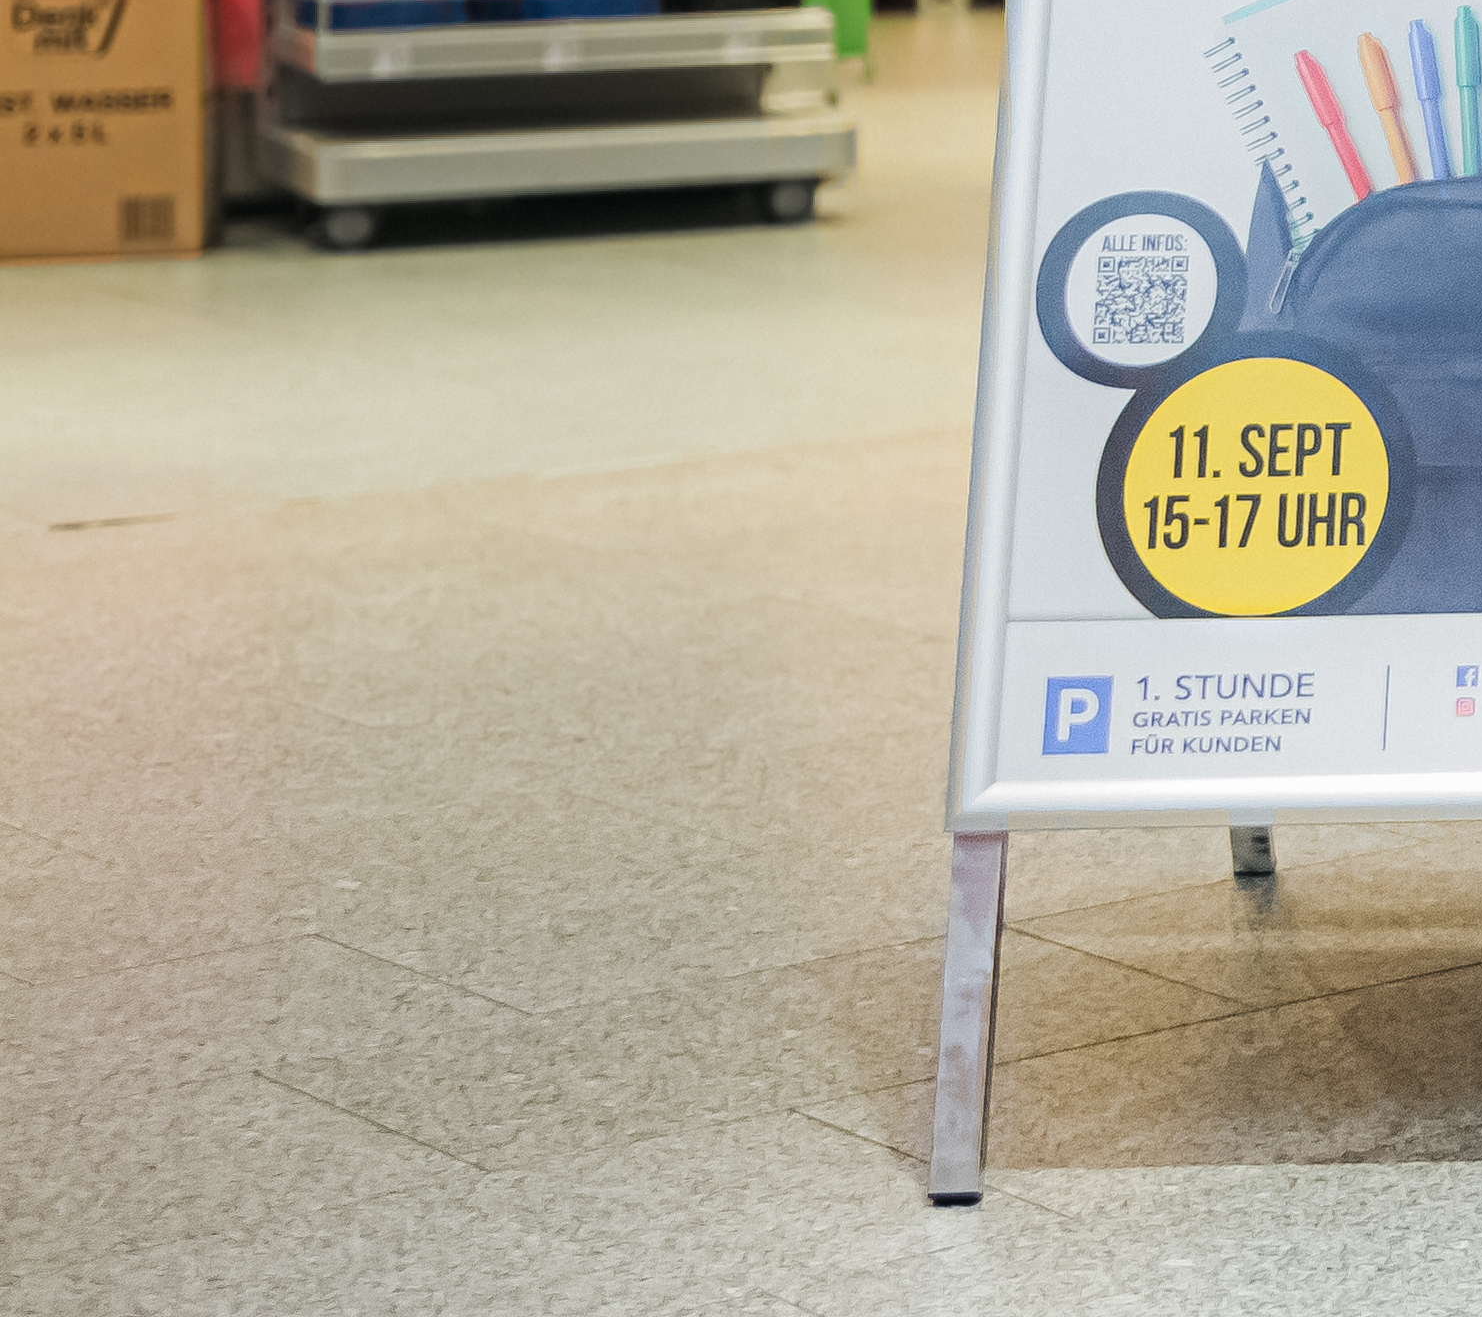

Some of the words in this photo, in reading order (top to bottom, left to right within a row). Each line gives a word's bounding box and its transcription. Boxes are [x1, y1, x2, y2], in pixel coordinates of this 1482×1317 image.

[1102, 234, 1138, 253] ALLE
[1141, 233, 1188, 252] INFOS:
[1169, 424, 1221, 479] 11.
[1239, 422, 1352, 477] SEPT
[1143, 494, 1262, 550] 15-17
[1276, 492, 1367, 548] UHR
[1137, 675, 1161, 701] 1.
[1175, 672, 1315, 700] STUNDE
[1056, 688, 1101, 743] P
[1133, 710, 1212, 728] GRATIS
[1219, 708, 1311, 726] PARKEN
[1130, 734, 1174, 754] FÜR
[1182, 735, 1282, 753] KUNDEN
